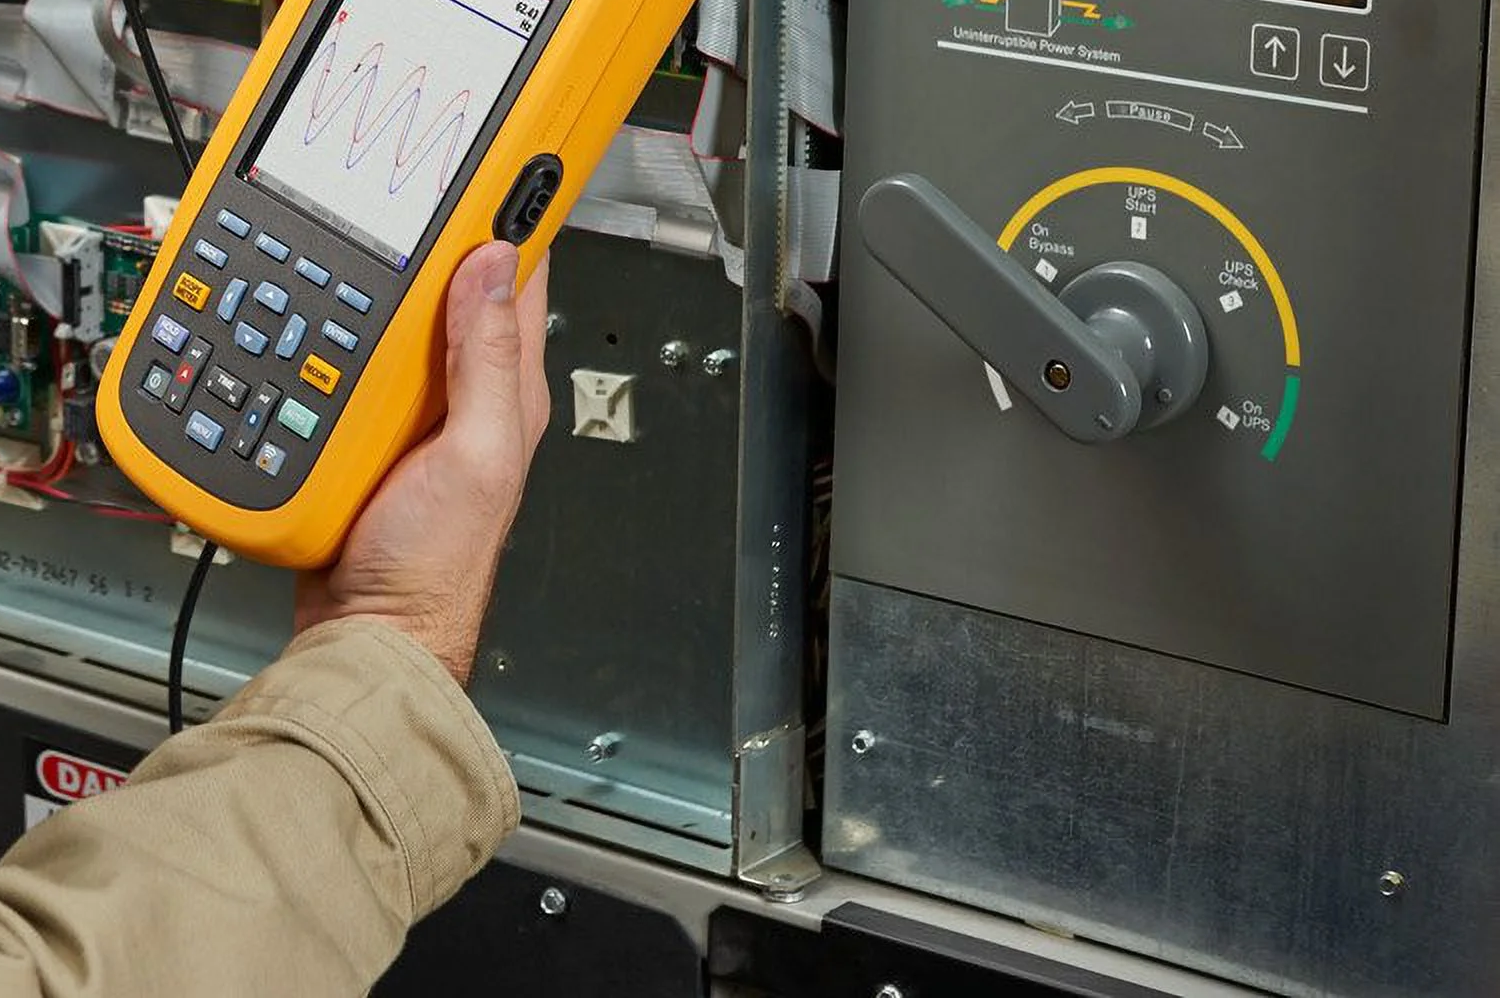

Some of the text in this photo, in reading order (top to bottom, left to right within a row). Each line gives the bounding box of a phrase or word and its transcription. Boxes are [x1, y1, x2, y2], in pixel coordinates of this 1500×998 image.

[953, 26, 1121, 62] Uninterruptible Power System
[1129, 104, 1171, 122] Pause
[1128, 186, 1157, 201] UPS
[1125, 198, 1157, 215] Start
[1031, 222, 1049, 237] On
[1029, 237, 1075, 256] Bypass
[1225, 260, 1254, 277] UPS
[1218, 271, 1259, 290] Check
[217, 373, 238, 391] TIME
[304, 363, 331, 385] RECORD
[1242, 399, 1263, 415] On
[1242, 415, 1271, 432] UPS
